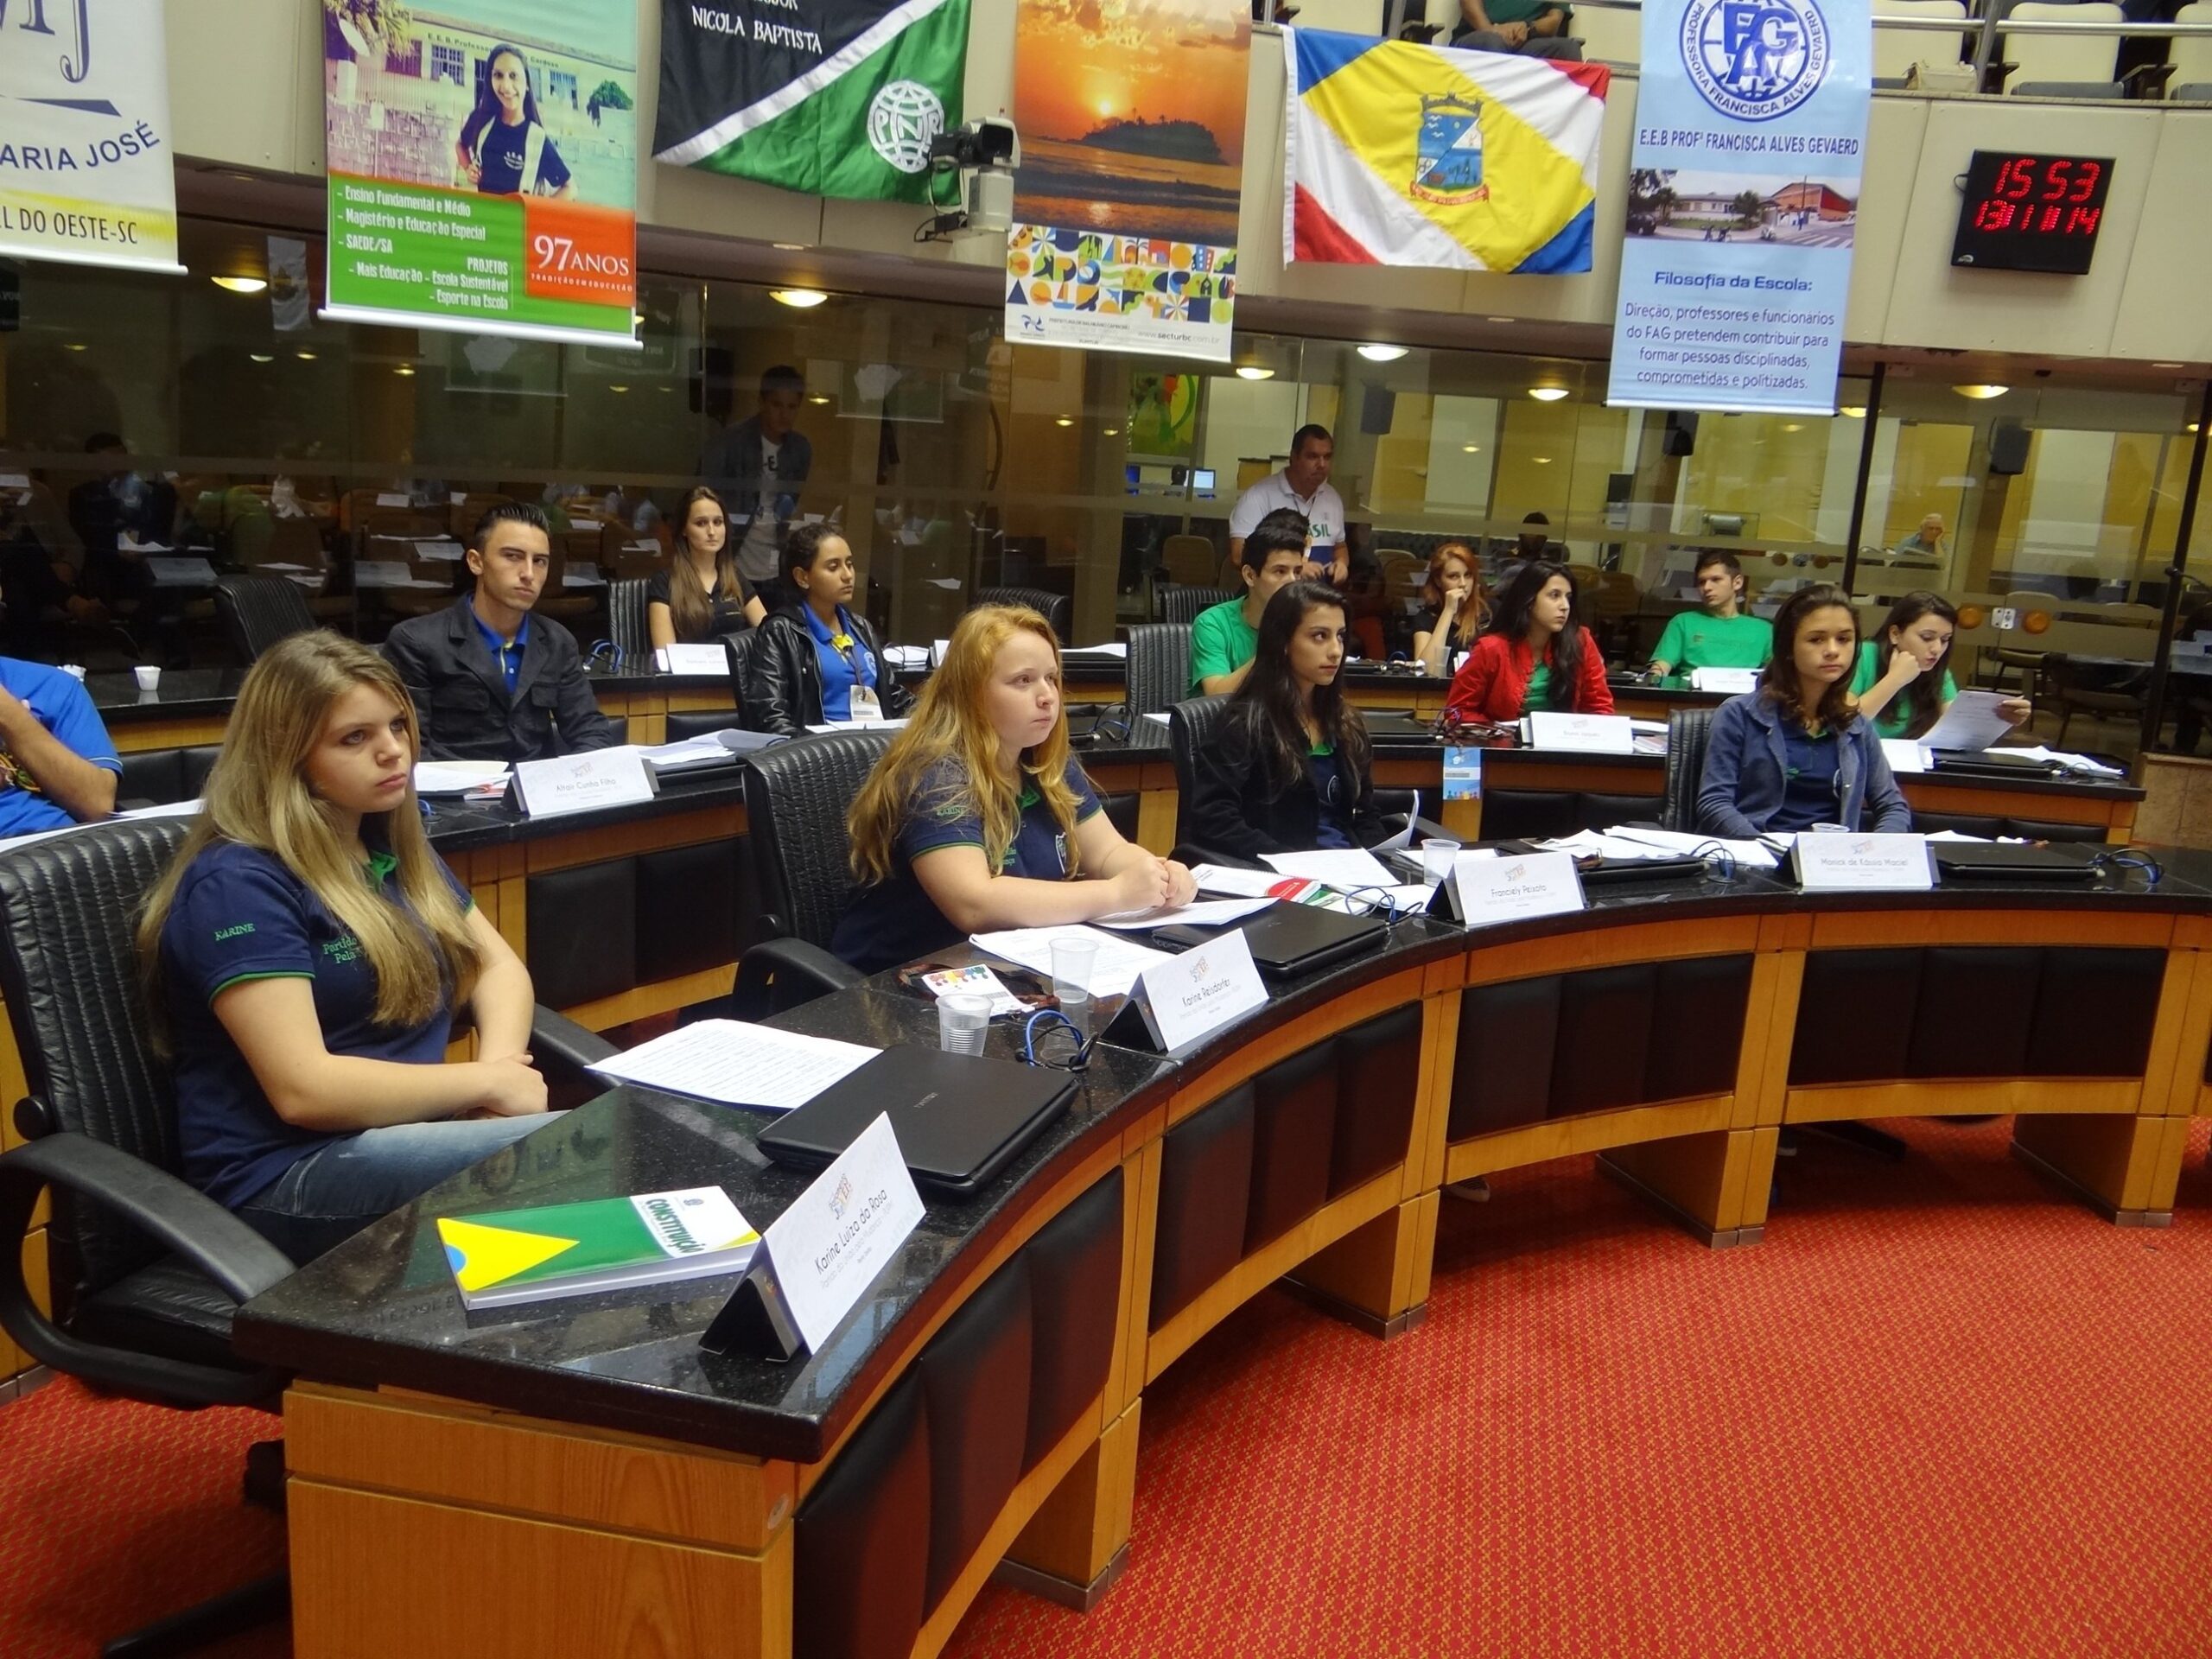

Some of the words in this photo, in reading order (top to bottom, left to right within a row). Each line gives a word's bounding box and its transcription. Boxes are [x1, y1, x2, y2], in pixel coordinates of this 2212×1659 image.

[692, 5, 746, 37] NICOLA
[753, 20, 823, 54] BAPTISTA
[1687, 3, 1711, 89] PROFESSORA
[1708, 86, 1780, 116] FRANCISCA
[1783, 73, 1816, 107] ALVES
[1804, 10, 1824, 71] GEVAERD
[86, 119, 161, 168] JOSÉ
[1706, 132, 1766, 151] FRANCISCA
[1769, 135, 1805, 153] ALVES
[1808, 137, 1859, 156] GEVAERD
[346, 185, 374, 204] Ensino
[377, 190, 435, 213] Fundamental
[444, 200, 471, 217] Médio
[20, 208, 46, 233] DO
[54, 212, 138, 244] OESTE-SC
[346, 208, 396, 229] Magistério
[405, 216, 449, 236] Educação
[452, 223, 486, 241] Especial
[467, 257, 508, 276] PROJETOS
[534, 235, 573, 271] 97
[570, 252, 629, 276] ANOS
[357, 262, 378, 277] Mais
[379, 264, 423, 283] Educação
[432, 270, 459, 287] Escola
[461, 274, 508, 293] Sustentável
[1655, 271, 1726, 289] Filosofia
[1729, 275, 1751, 289] da
[1754, 276, 1813, 291] Escola:
[436, 289, 469, 307] Esporte
[471, 297, 481, 308] na
[483, 295, 508, 310] Escola
[1625, 302, 1673, 321] Direção,
[1676, 306, 1750, 322] professores
[1751, 312, 1759, 321] e
[1762, 308, 1835, 326] funcionários
[1626, 325, 1643, 339] do
[1645, 326, 1671, 340] FAG
[1674, 327, 1740, 343] pretendem
[1743, 332, 1801, 346] contribuir
[1802, 335, 1828, 348] para
[1639, 347, 1678, 362] formar
[1681, 351, 1731, 365] pessoas
[1733, 351, 1811, 370] disciplinadas,
[1637, 370, 1729, 385] comprometidas
[1732, 376, 1739, 385] e
[1742, 372, 1808, 390] politizadas.
[1308, 524, 1331, 537] SIL
[215, 923, 256, 941] KARINE
[814, 1243, 841, 1275] Karine
[838, 1220, 861, 1247] Luiza
[859, 1208, 871, 1224] da
[868, 1189, 887, 1212] Rosa
